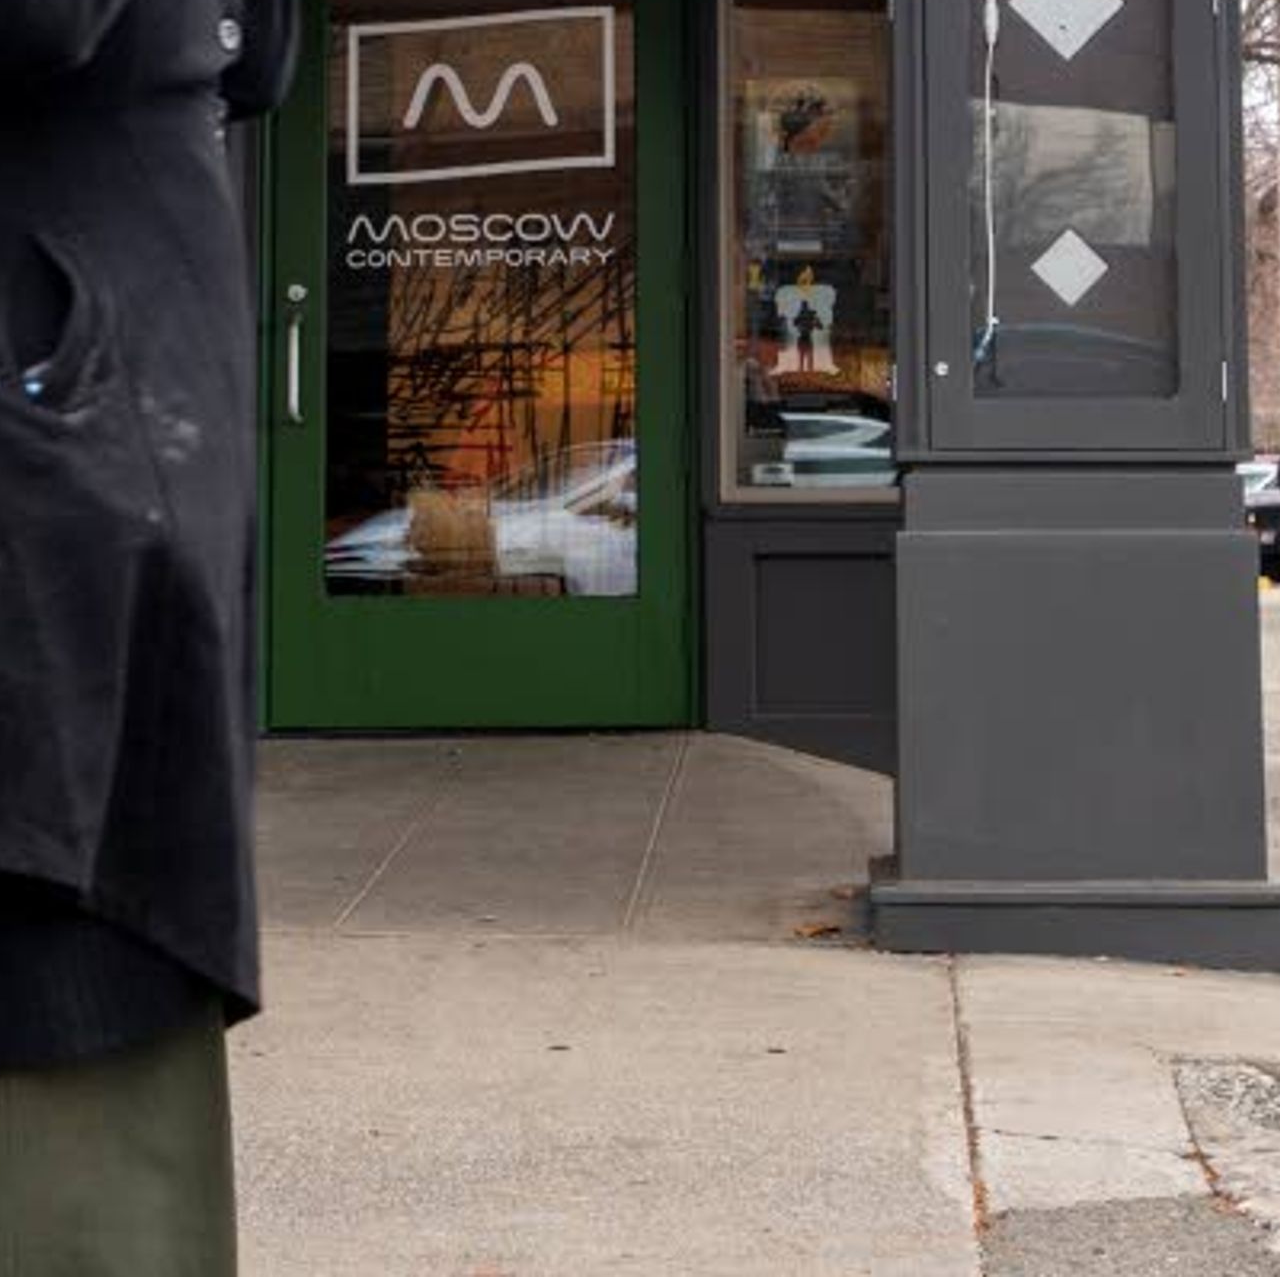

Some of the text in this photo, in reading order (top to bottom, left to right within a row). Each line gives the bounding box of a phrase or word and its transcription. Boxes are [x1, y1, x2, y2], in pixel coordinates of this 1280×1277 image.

[404, 63, 558, 128] M
[348, 213, 615, 244] MOSCOW
[347, 248, 615, 269] CONTEMPORARY
